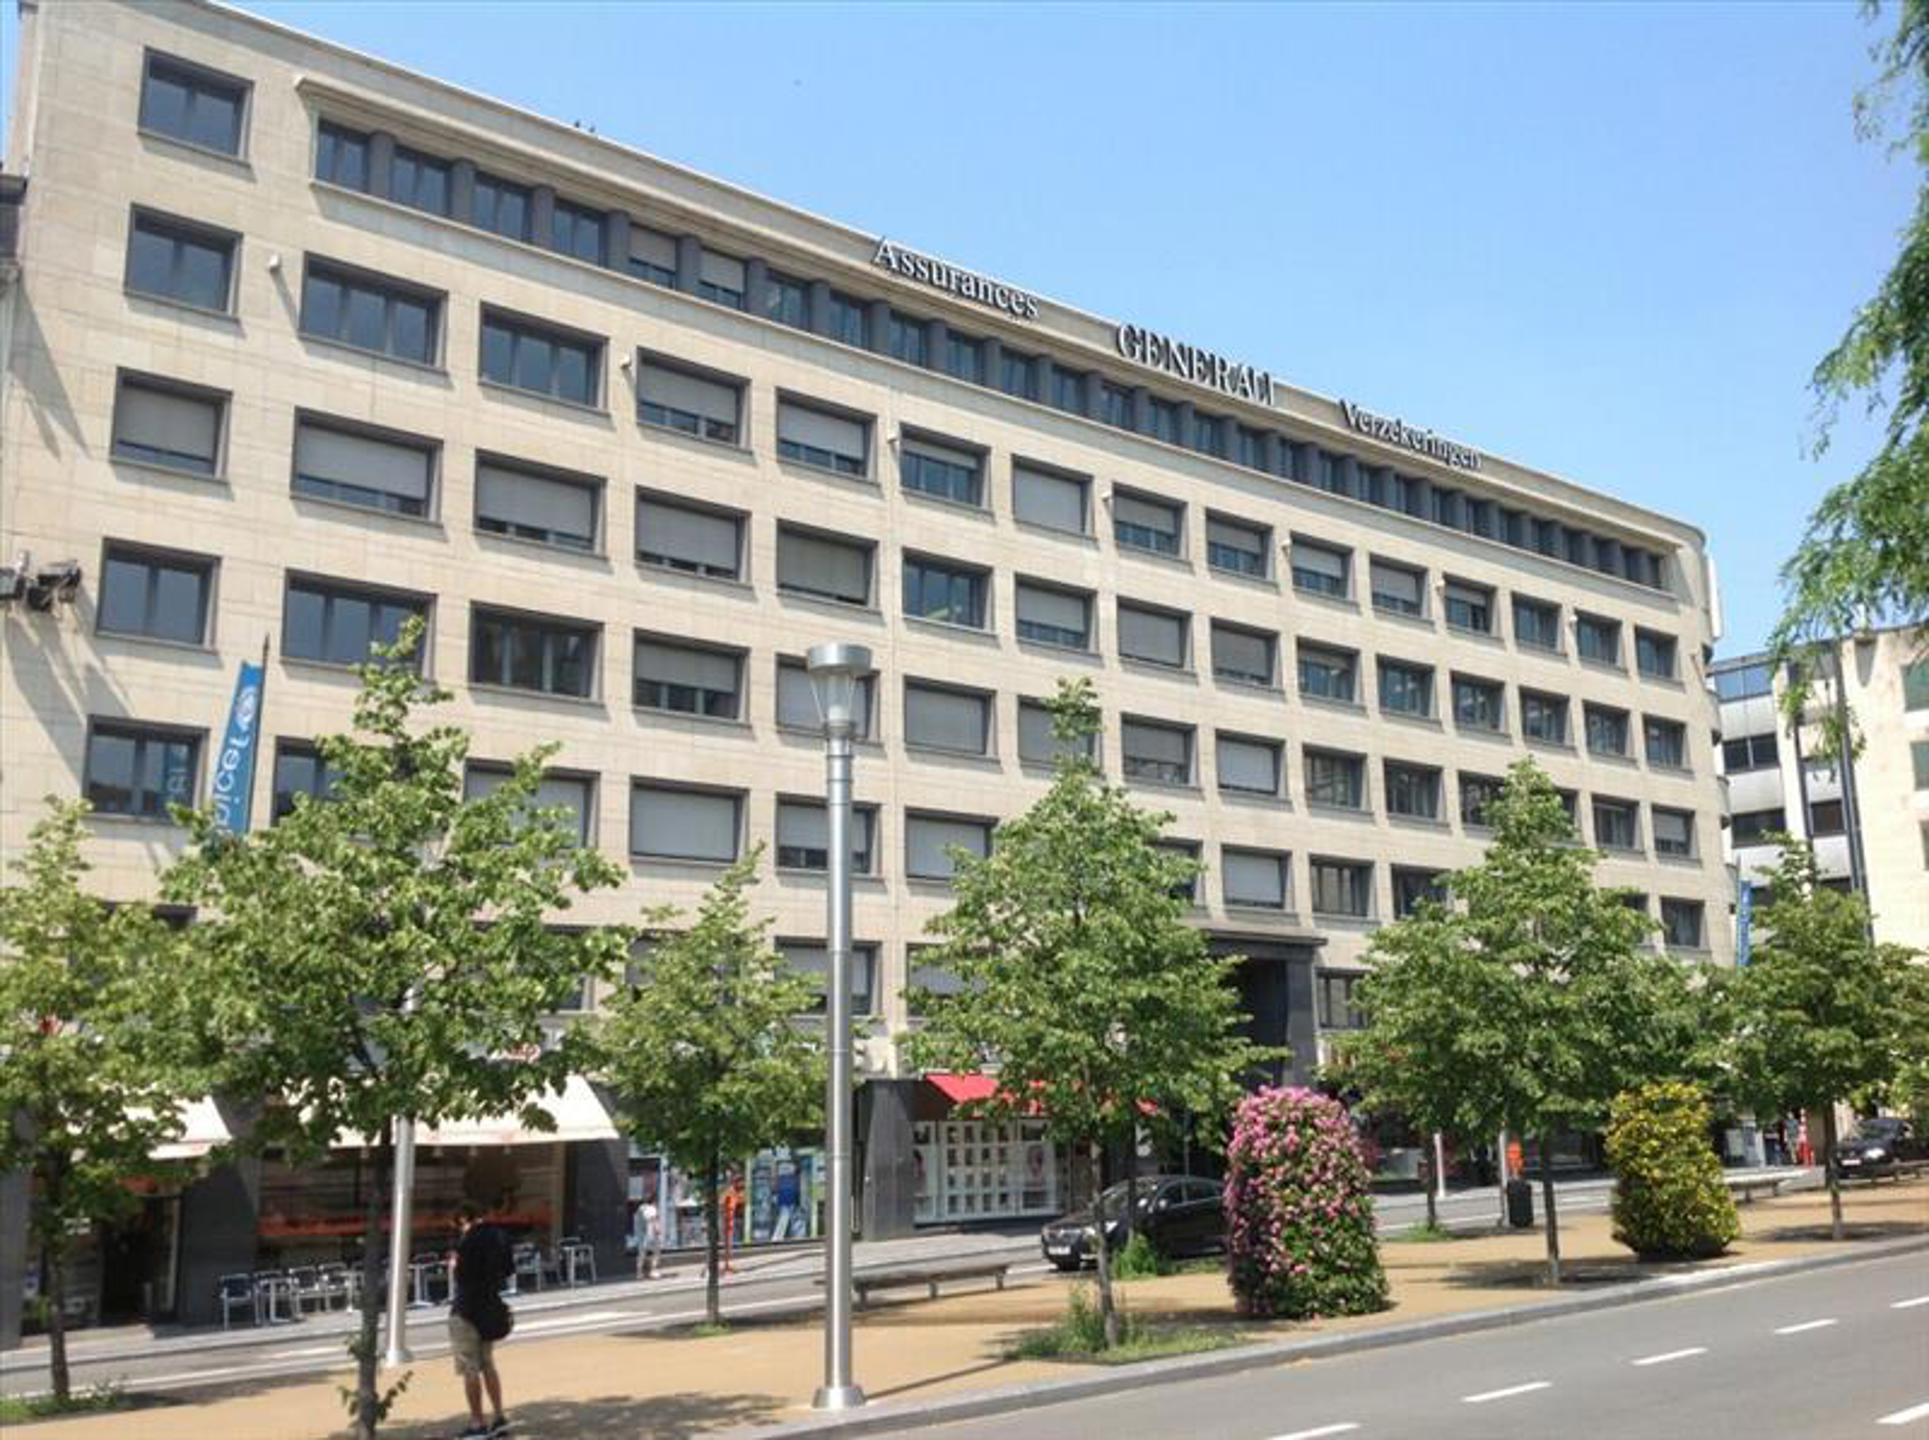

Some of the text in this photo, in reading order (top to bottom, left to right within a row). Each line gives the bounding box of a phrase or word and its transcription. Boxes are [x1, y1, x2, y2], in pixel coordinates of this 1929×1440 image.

[872, 236, 1482, 469] Assurances GENERALI Verzekeringen
